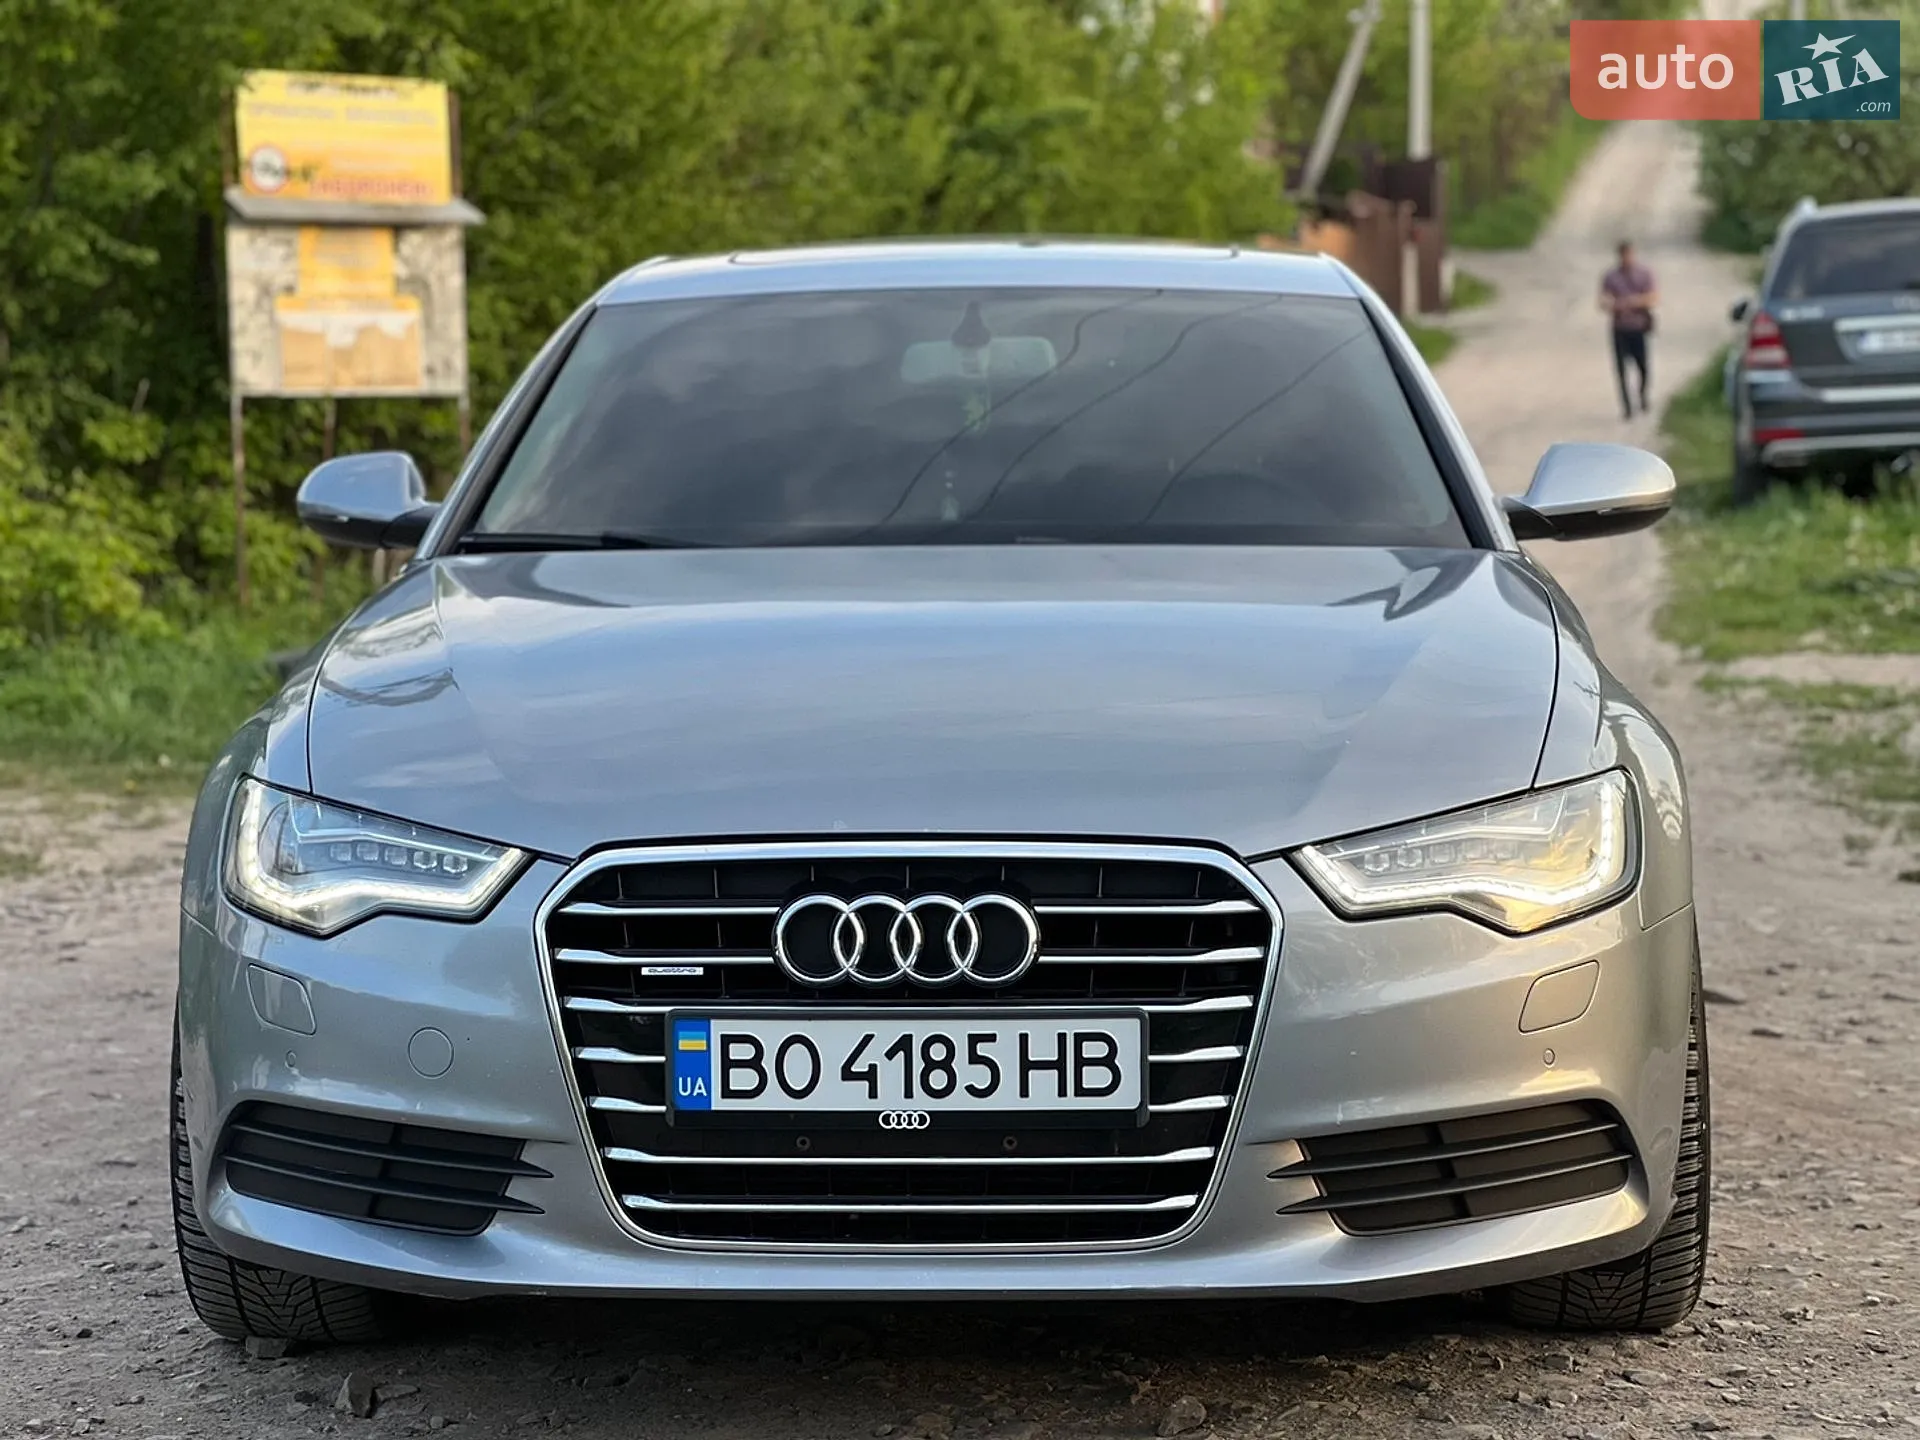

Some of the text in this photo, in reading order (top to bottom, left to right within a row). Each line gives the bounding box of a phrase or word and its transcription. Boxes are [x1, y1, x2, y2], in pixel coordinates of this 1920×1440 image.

[678, 1077, 708, 1097] UA
[719, 1032, 1122, 1100] BO 4185 HB
